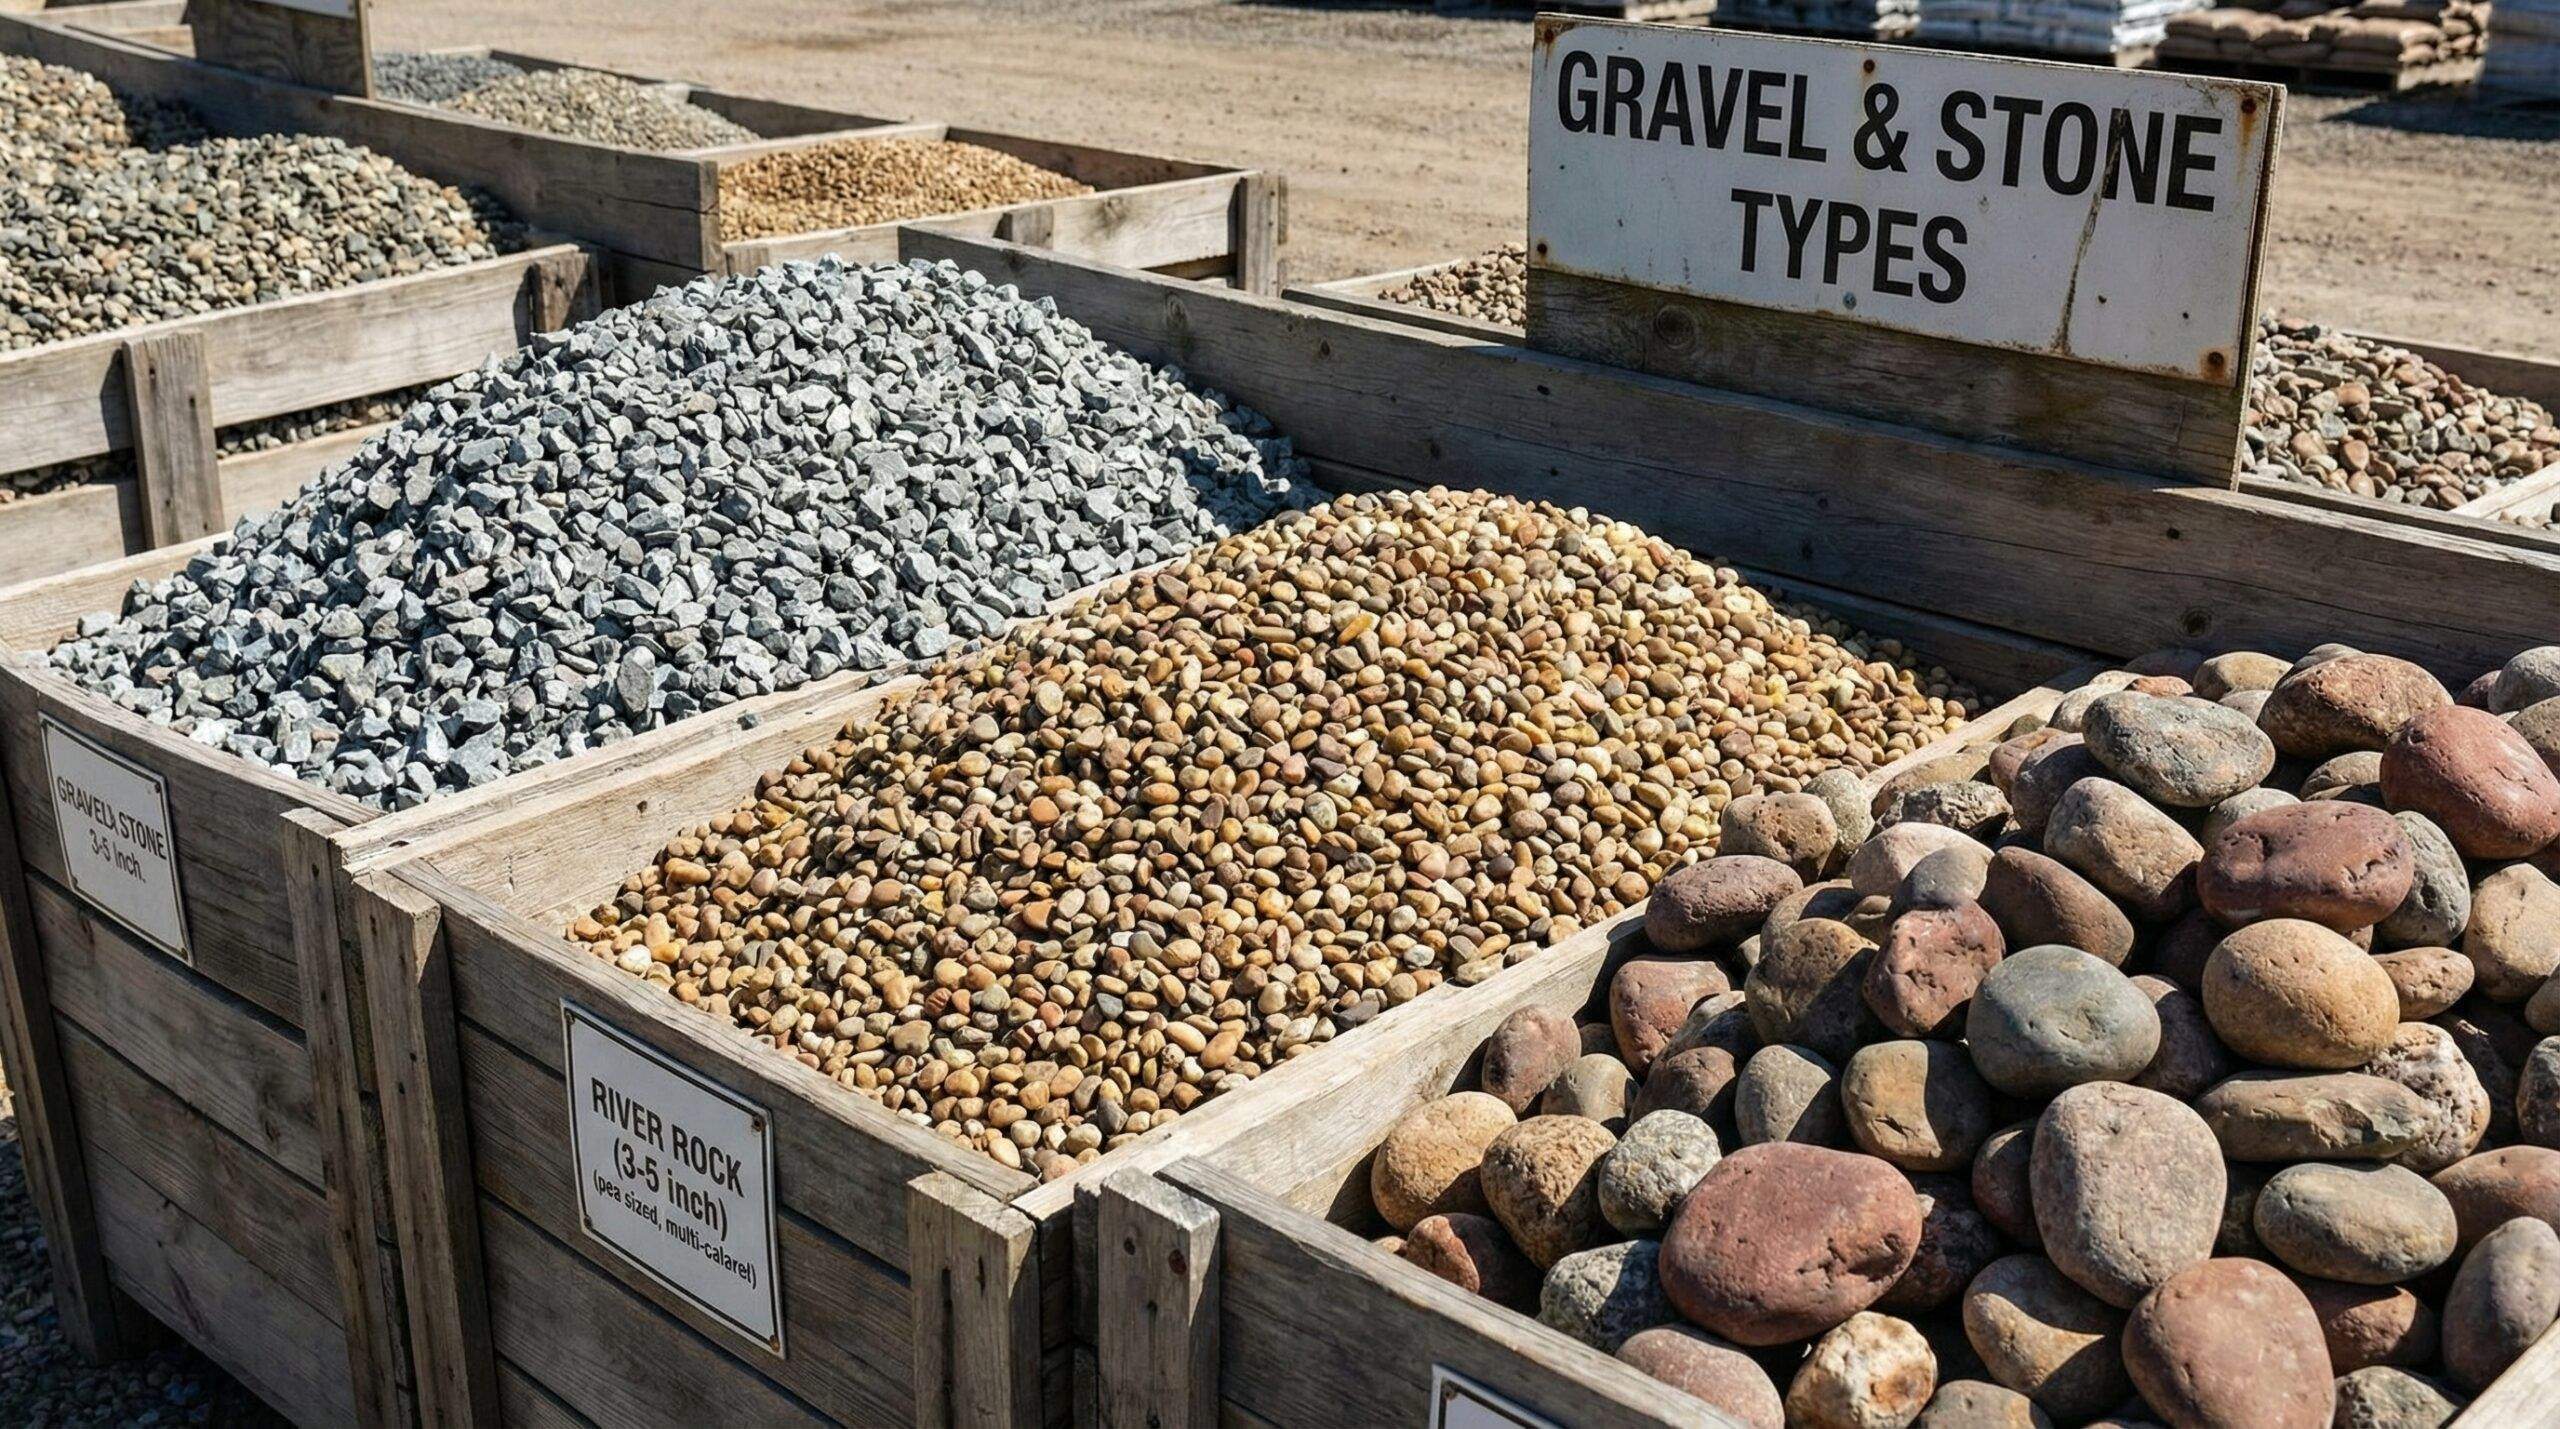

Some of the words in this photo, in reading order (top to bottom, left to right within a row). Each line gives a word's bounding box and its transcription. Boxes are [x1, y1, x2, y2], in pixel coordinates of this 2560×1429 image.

[1558, 50, 1827, 163] GRAVEL
[1853, 83, 1909, 173] &
[1936, 90, 2222, 212] STONE
[1731, 187, 1967, 304] TYPES
[119, 812, 167, 860] STONE
[591, 1077, 664, 1152] RIVER
[672, 1124, 744, 1198] ROCK
[614, 1137, 659, 1193] (3-5
[668, 1168, 727, 1241] inch)
[593, 1169, 621, 1202] (pea
[625, 1190, 661, 1231] sized,
